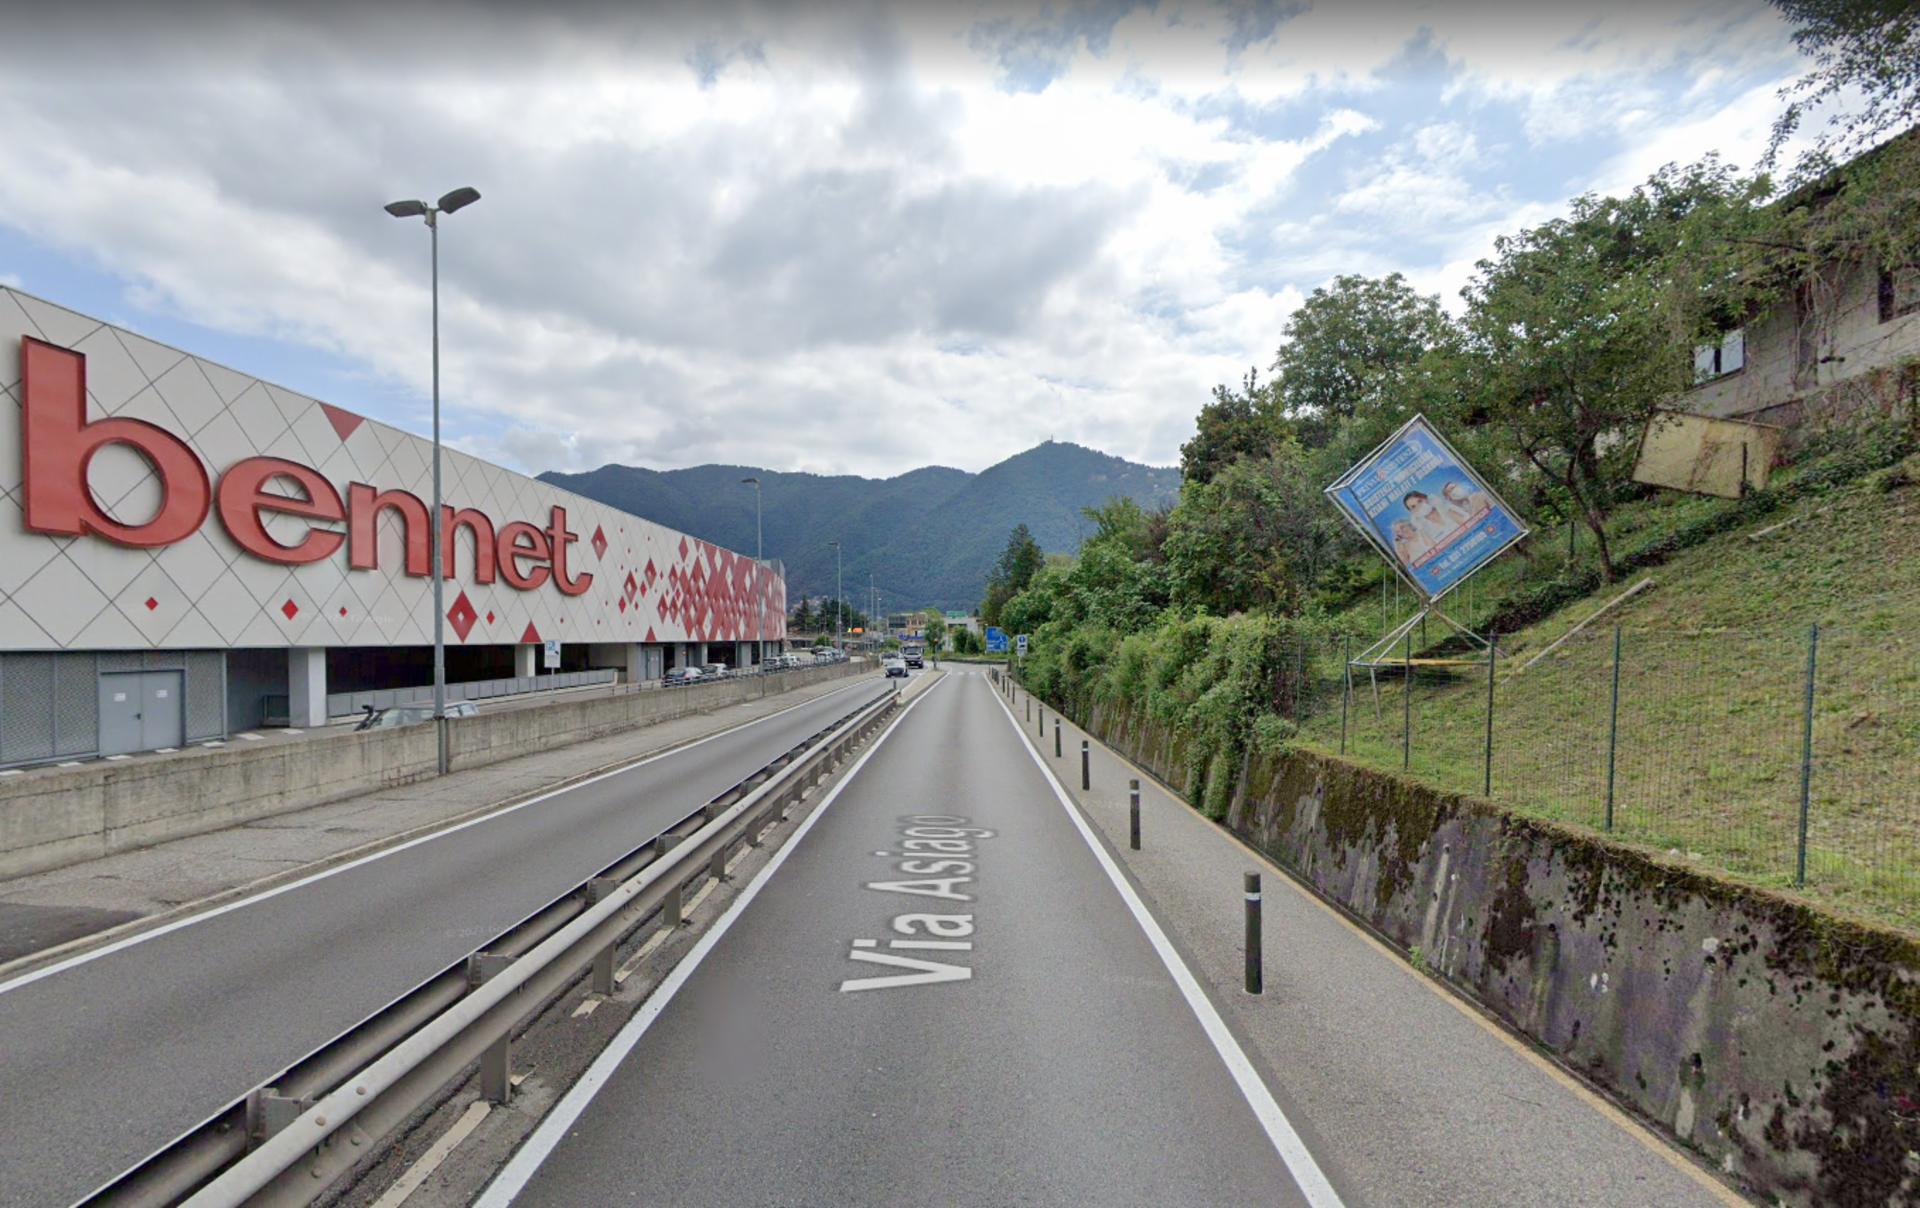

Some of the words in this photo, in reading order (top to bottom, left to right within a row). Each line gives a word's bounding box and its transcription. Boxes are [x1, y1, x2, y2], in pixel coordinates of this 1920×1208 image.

[22, 334, 594, 596] bennet
[866, 814, 997, 901] Asiago
[839, 913, 974, 992] Via
